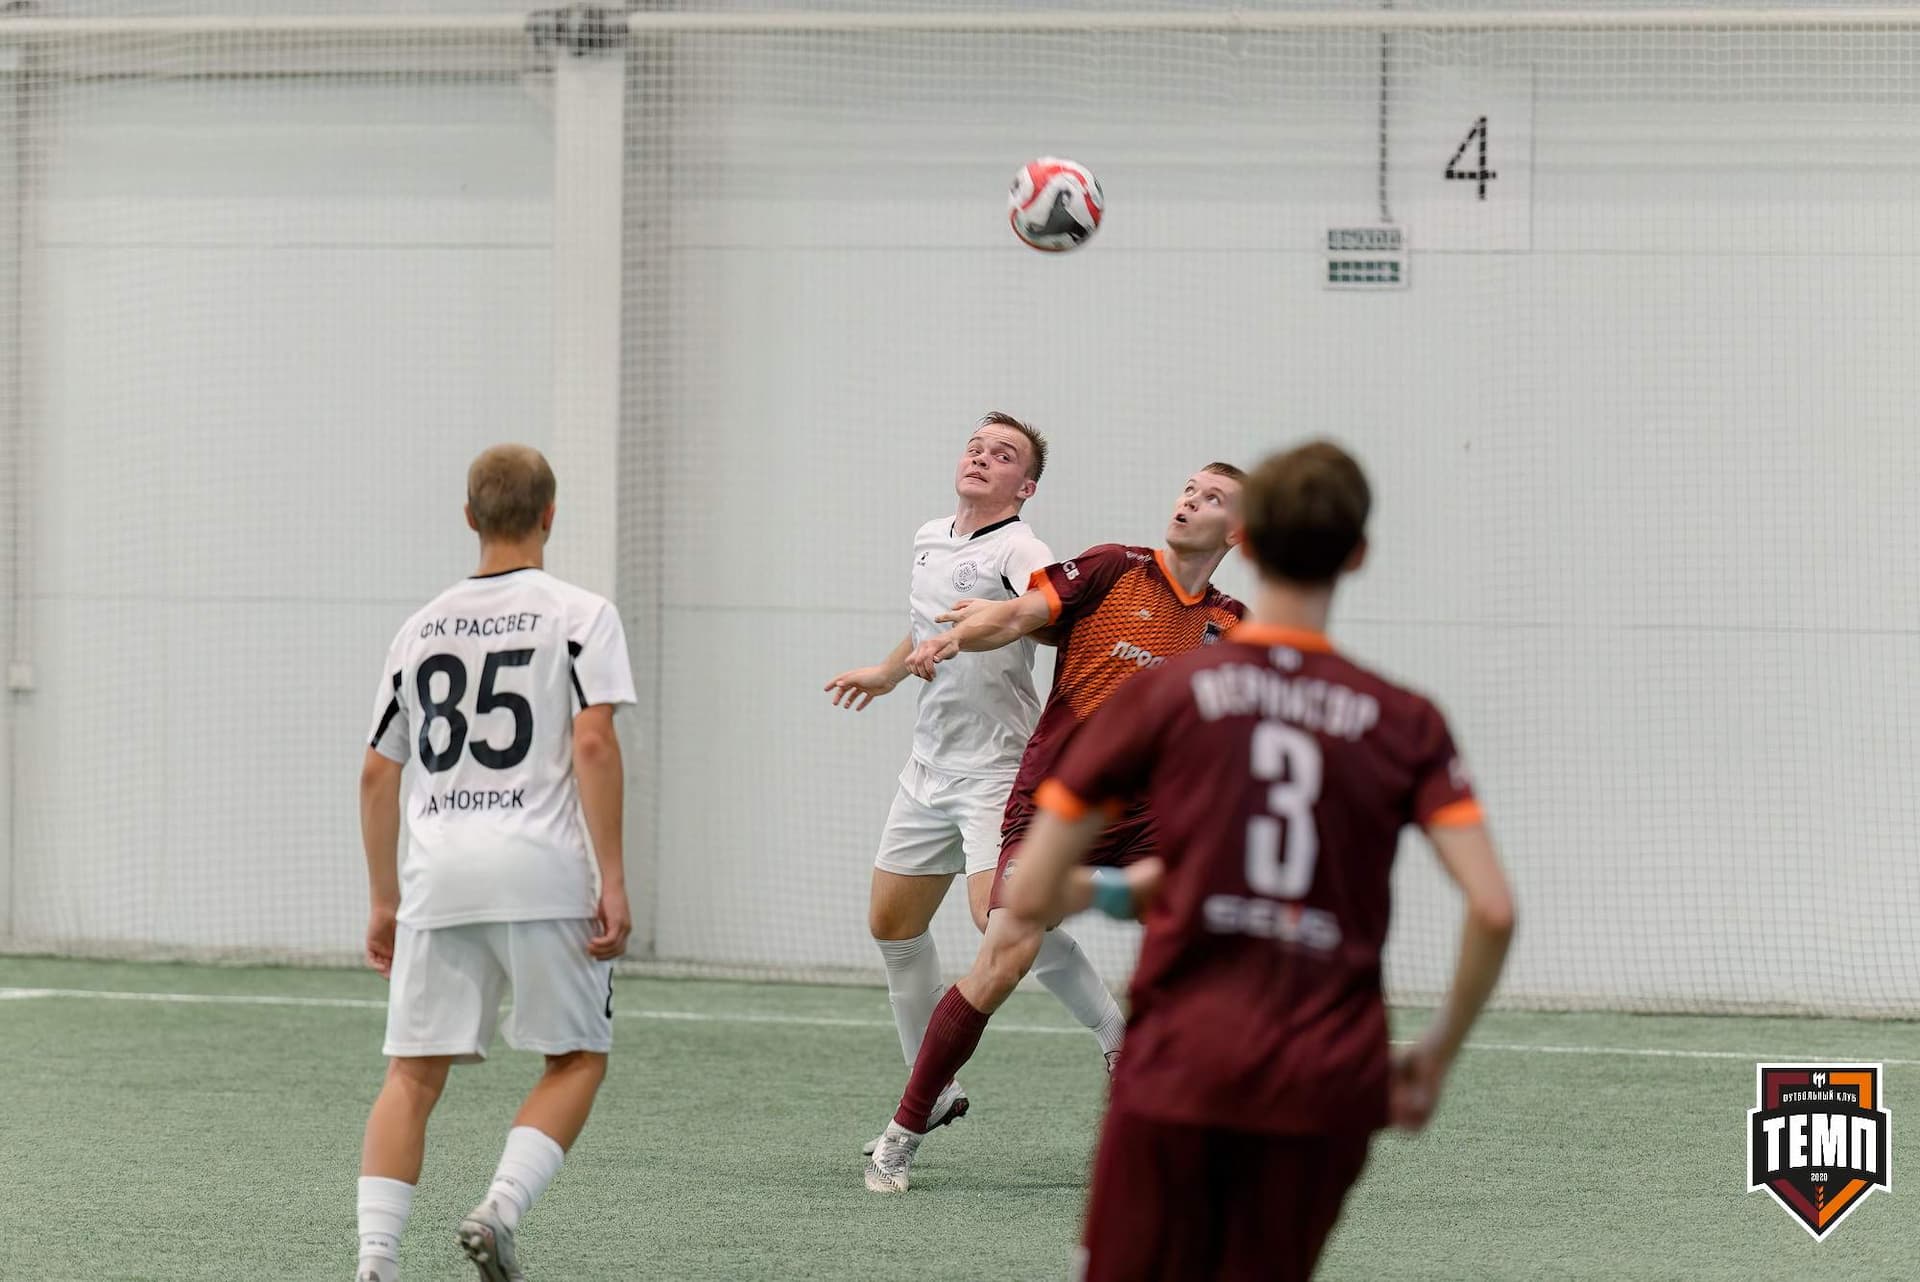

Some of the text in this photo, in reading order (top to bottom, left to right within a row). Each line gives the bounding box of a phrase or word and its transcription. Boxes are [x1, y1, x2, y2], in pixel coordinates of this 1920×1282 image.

[1445, 116, 1497, 201] 4
[420, 613, 542, 639] ФК РАССВЕТ
[416, 648, 536, 775] 85
[417, 788, 525, 819] АНОЯРСК
[1244, 719, 1323, 899] 3
